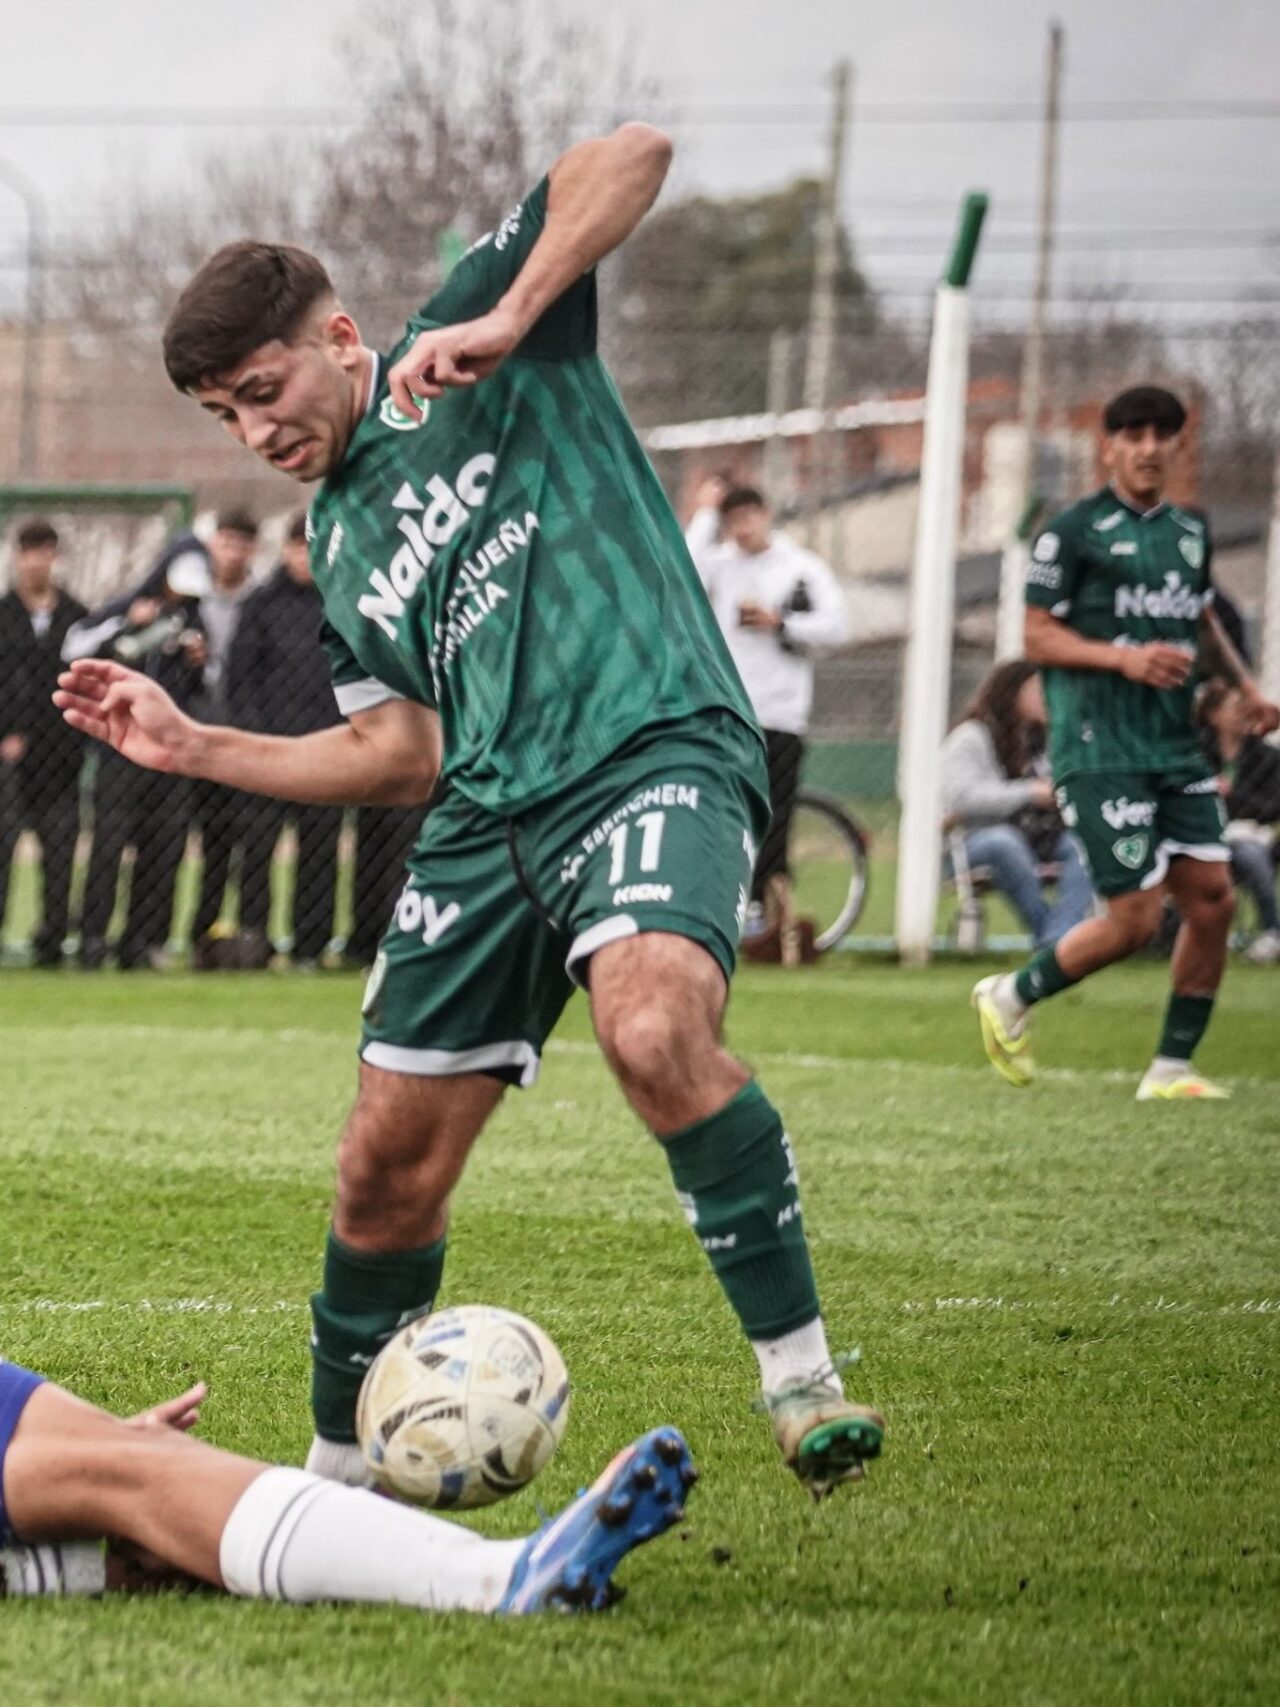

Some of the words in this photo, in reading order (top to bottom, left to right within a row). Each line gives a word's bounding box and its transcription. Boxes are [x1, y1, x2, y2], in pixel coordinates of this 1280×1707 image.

[357, 452, 496, 642] Naldo
[608, 811, 665, 886] 11
[613, 883, 673, 906] KION
